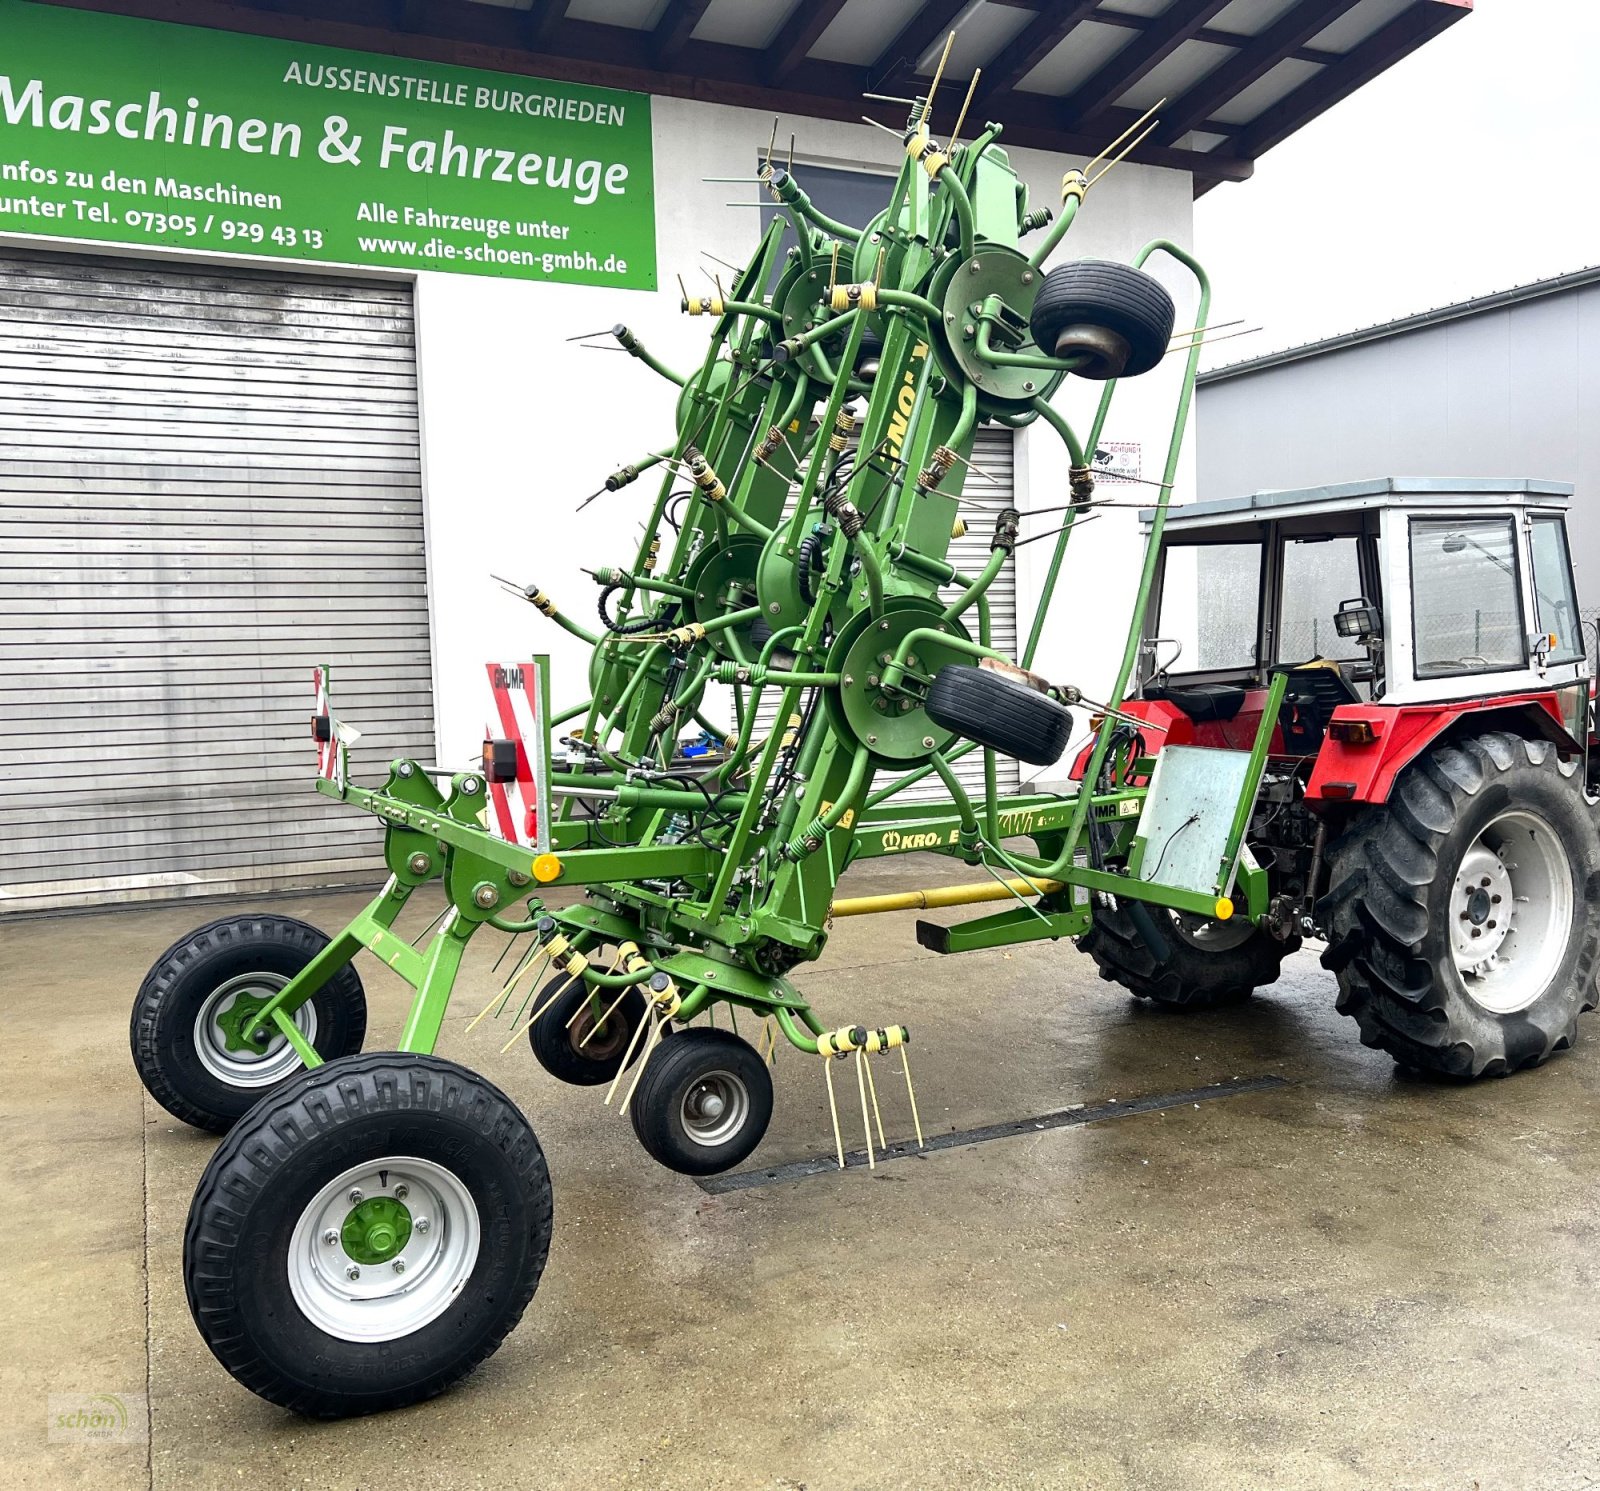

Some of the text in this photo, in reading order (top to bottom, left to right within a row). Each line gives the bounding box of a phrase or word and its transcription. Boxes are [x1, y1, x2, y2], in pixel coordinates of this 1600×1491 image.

[283, 61, 625, 127] AUSSENSTELLE BURGRIEDEN
[0, 75, 629, 206] Maschinen & Fahrzeuge
[2, 159, 282, 210] nfos zu den Maschinen
[0, 195, 324, 250] unter Tel. 07305 / 929 43 13
[356, 202, 570, 241] Alle Fahrzeuge unter
[357, 237, 628, 274] www.die-schoen-gmbh.de
[494, 667, 525, 690] GRUMA
[901, 829, 960, 850] KROE
